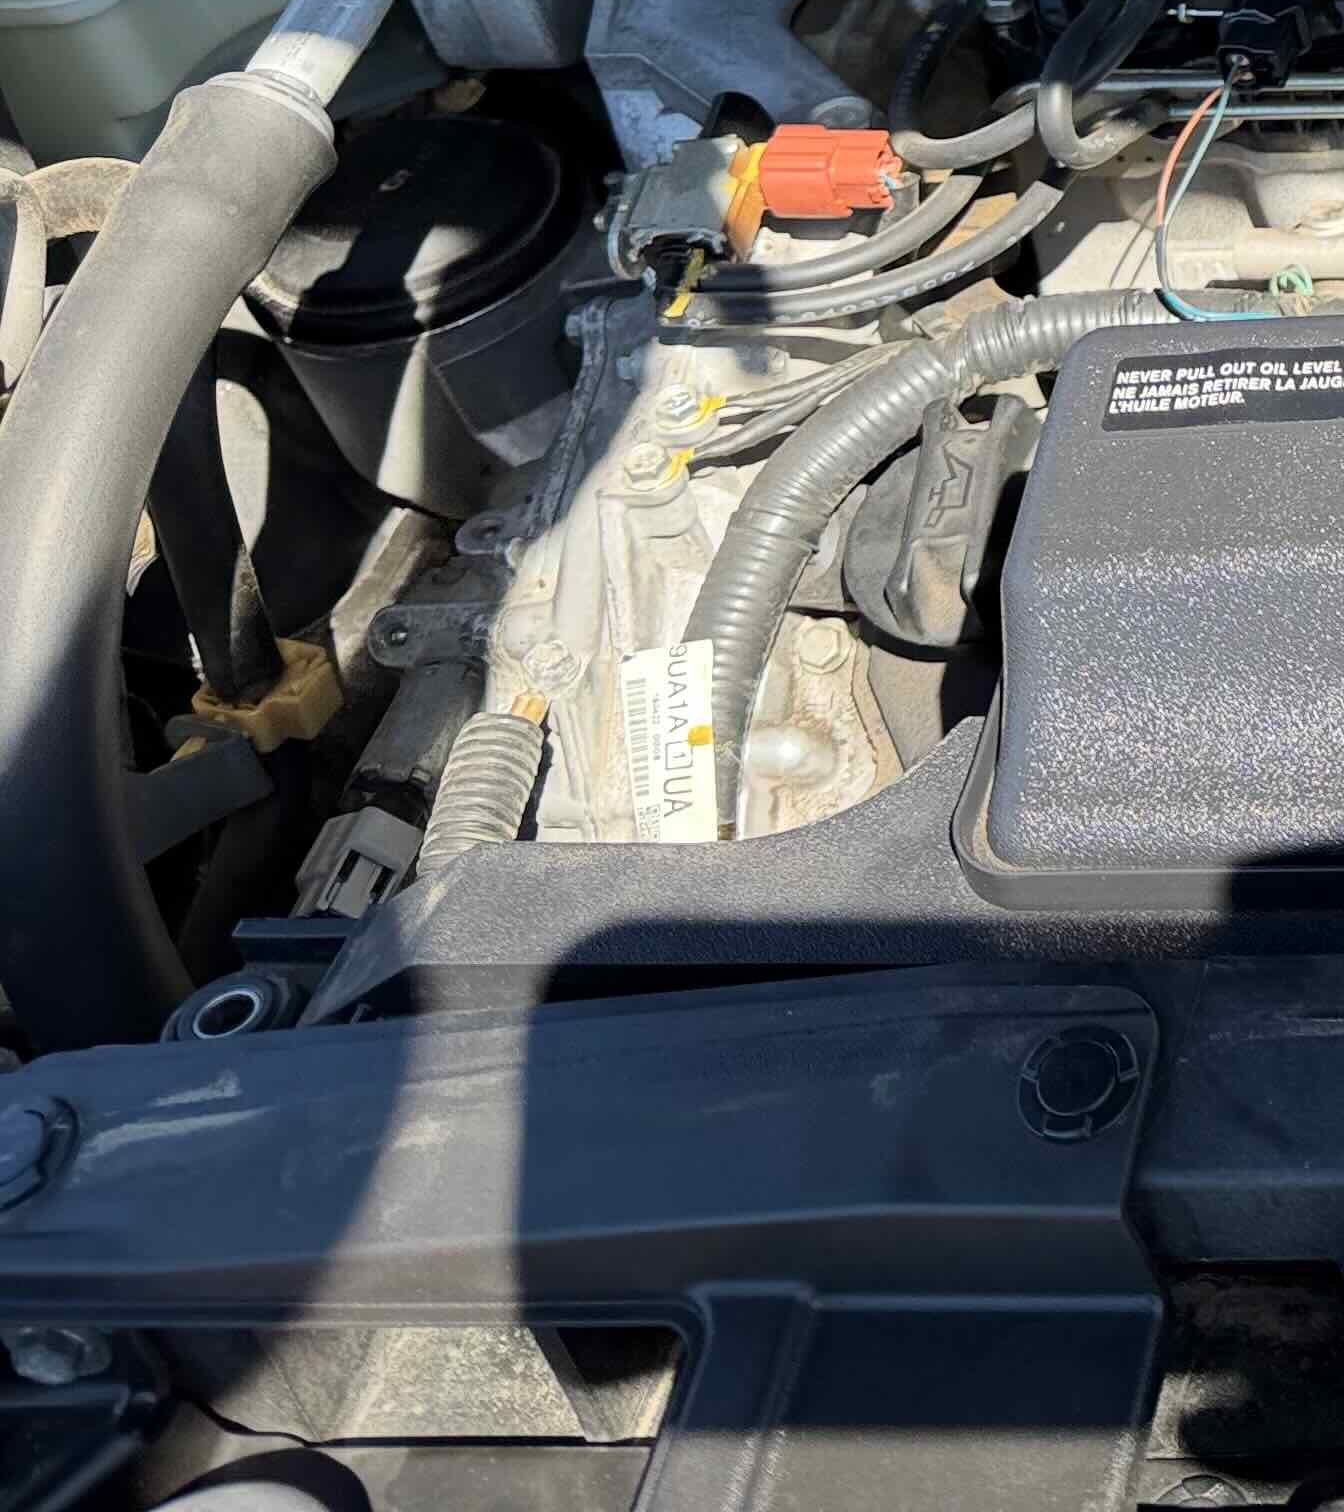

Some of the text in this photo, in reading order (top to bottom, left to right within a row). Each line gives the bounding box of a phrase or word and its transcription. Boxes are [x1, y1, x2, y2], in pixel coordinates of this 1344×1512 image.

[1116, 369, 1173, 384] NEVER
[1176, 365, 1215, 381] PULL
[1220, 362, 1256, 376] OUT
[1260, 362, 1288, 376] OIL
[1293, 361, 1342, 376] LEVEL
[1112, 387, 1137, 400] NE
[1139, 383, 1199, 399] JAMAIS
[1203, 378, 1271, 393] RETIRER
[1275, 378, 1296, 391] LA
[1109, 391, 1245, 414] L'HUILE MOTEUR.
[663, 775, 693, 818] UA
